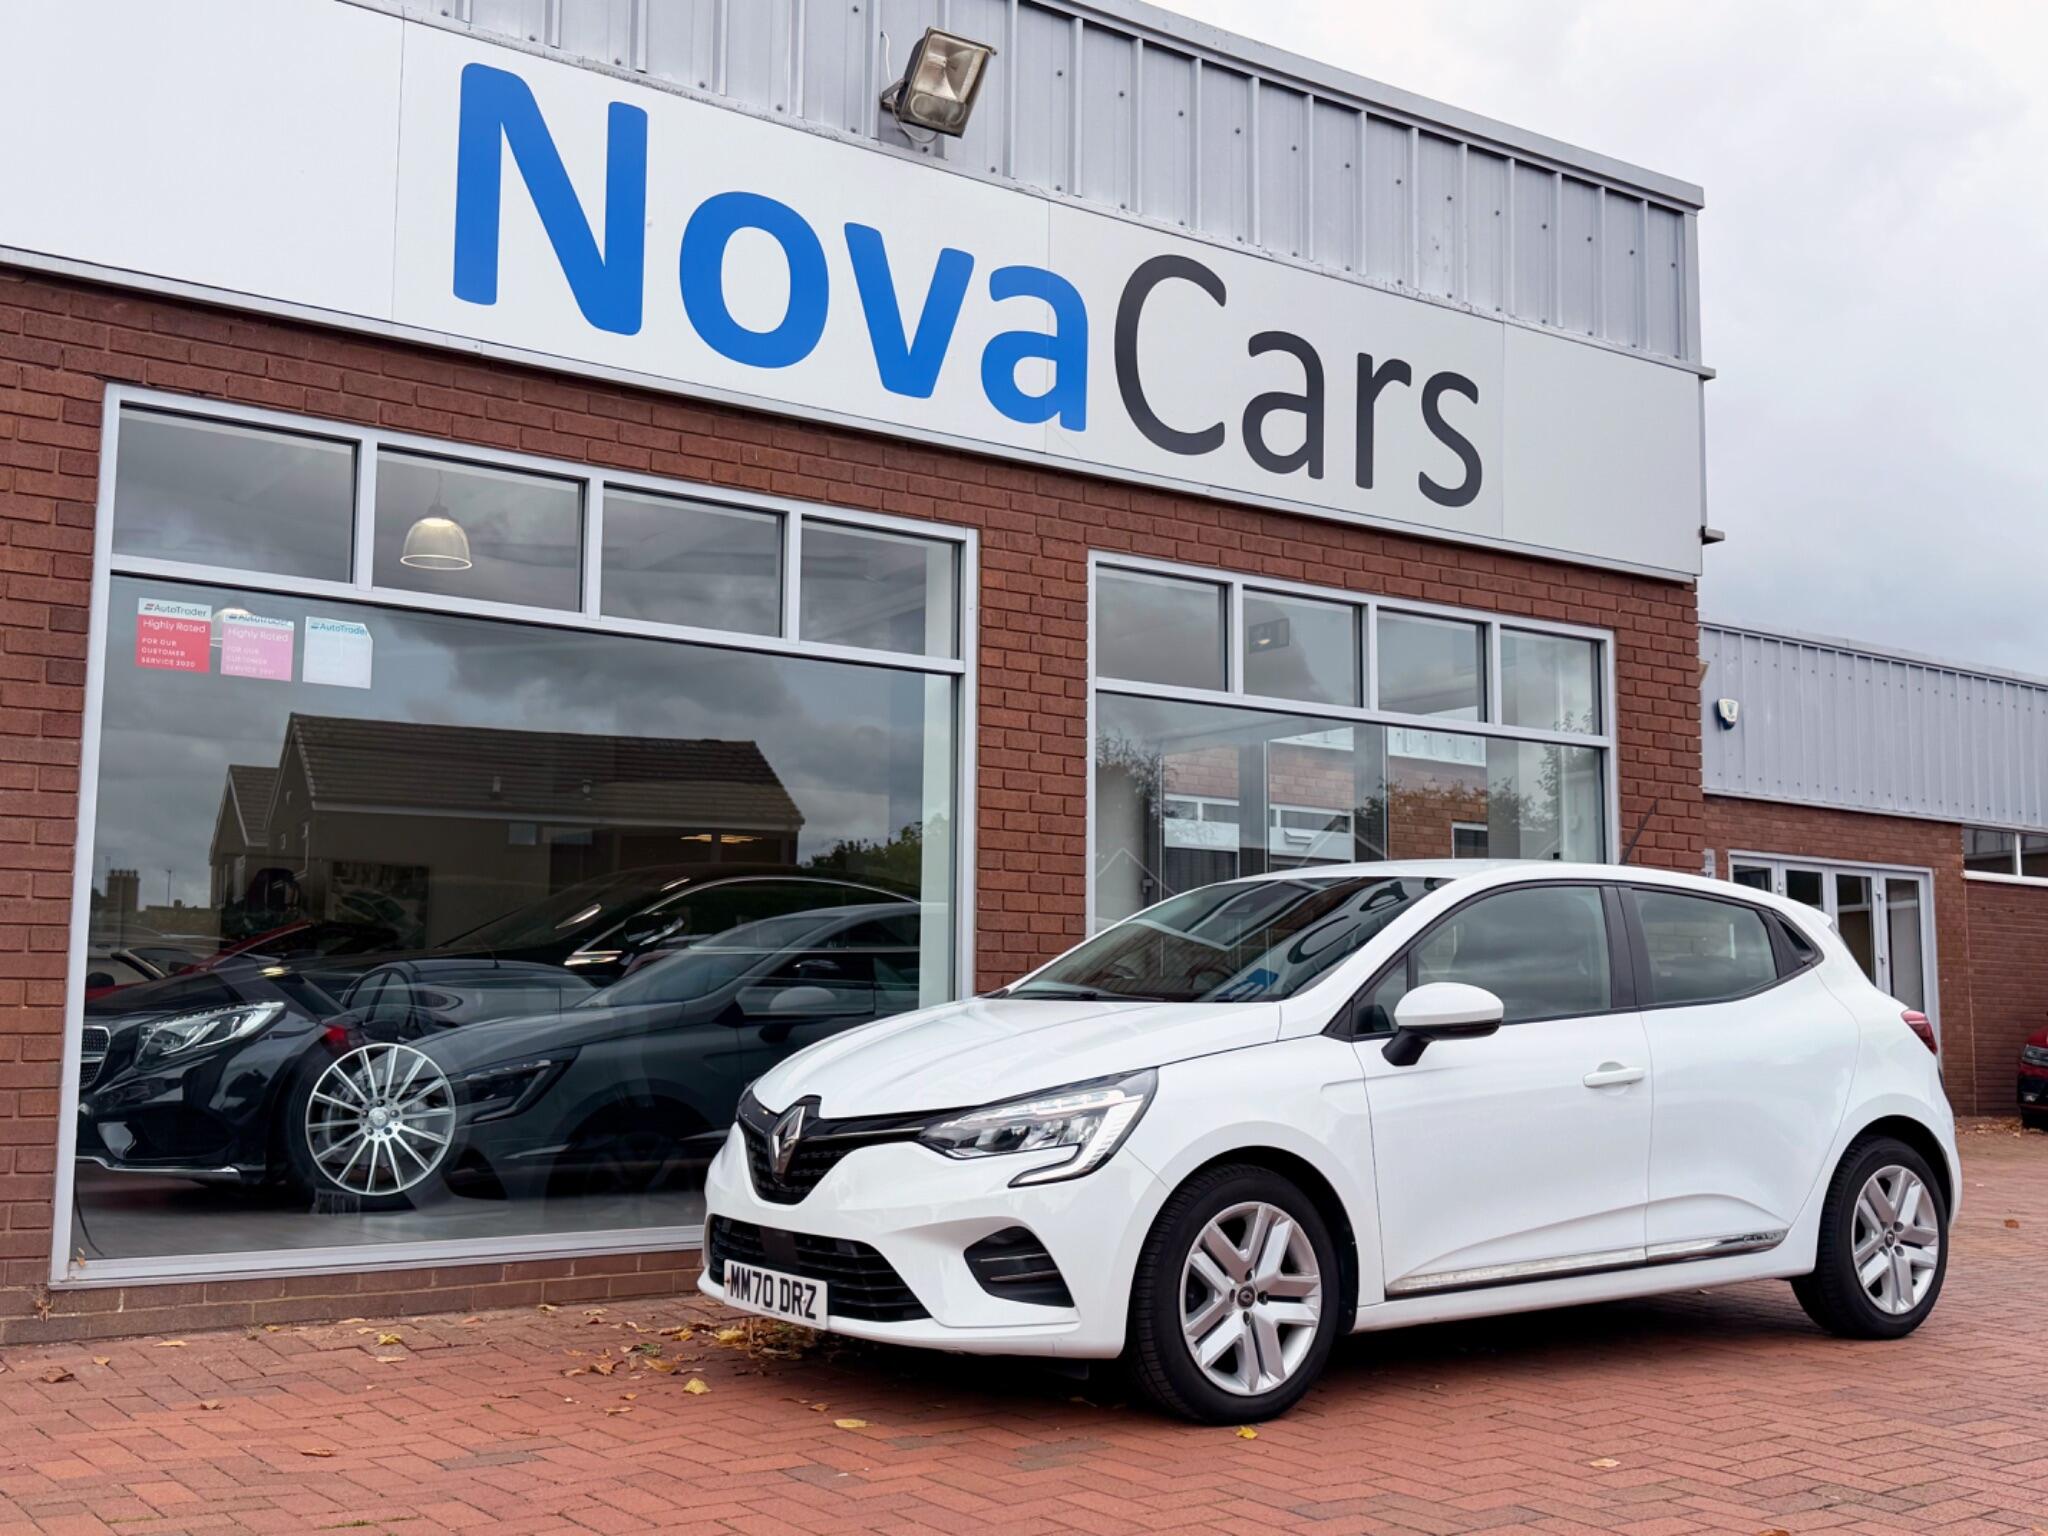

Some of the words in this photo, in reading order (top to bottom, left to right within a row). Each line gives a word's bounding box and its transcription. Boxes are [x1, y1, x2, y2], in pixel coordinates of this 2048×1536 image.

[153, 603, 207, 617] AutoTrader
[143, 619, 175, 631] Highly
[176, 622, 206, 633] Rated
[142, 637, 158, 645] FOR
[160, 639, 177, 647] OUR
[141, 646, 186, 657] CUSTOMER
[141, 656, 174, 667] SERVICE
[730, 1264, 774, 1308] MM70
[779, 1277, 817, 1320] DRZ
